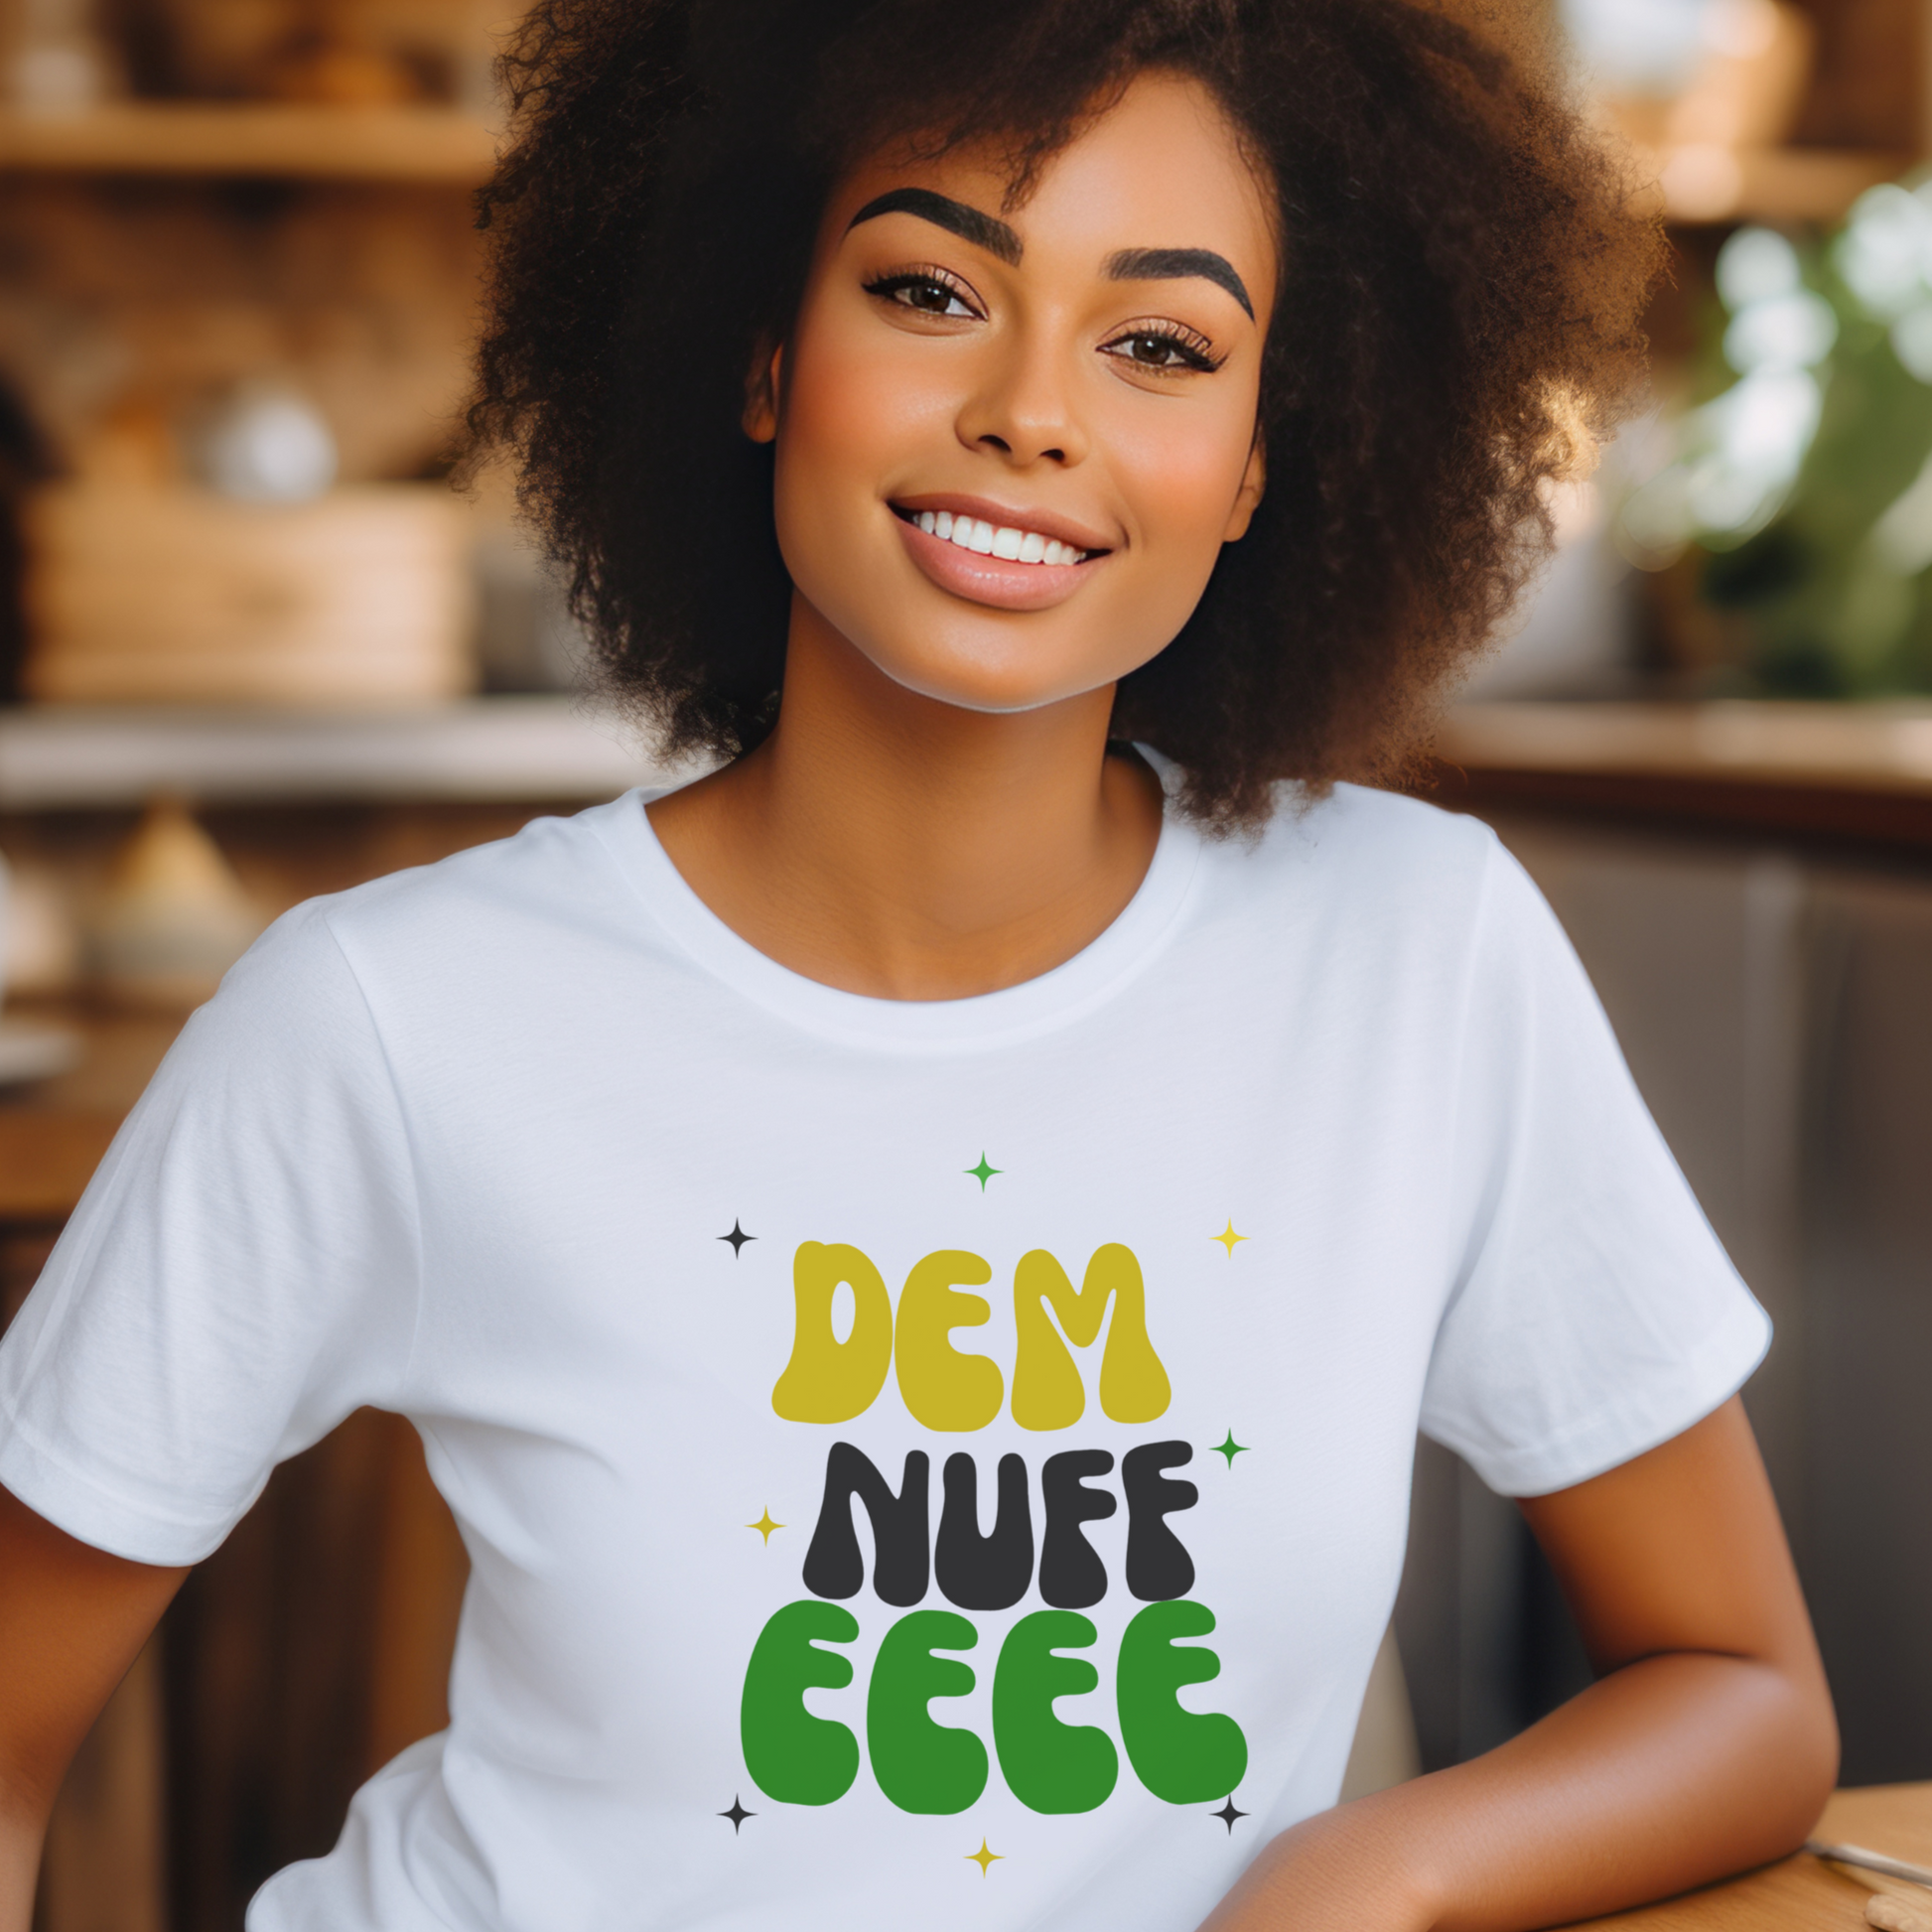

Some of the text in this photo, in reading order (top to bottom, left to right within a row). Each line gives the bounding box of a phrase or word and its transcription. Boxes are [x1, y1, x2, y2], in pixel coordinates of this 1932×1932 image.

[771, 1240, 1172, 1433] DEM
[802, 1440, 1199, 1611] NUFF
[741, 1599, 1248, 1815] EEEE
